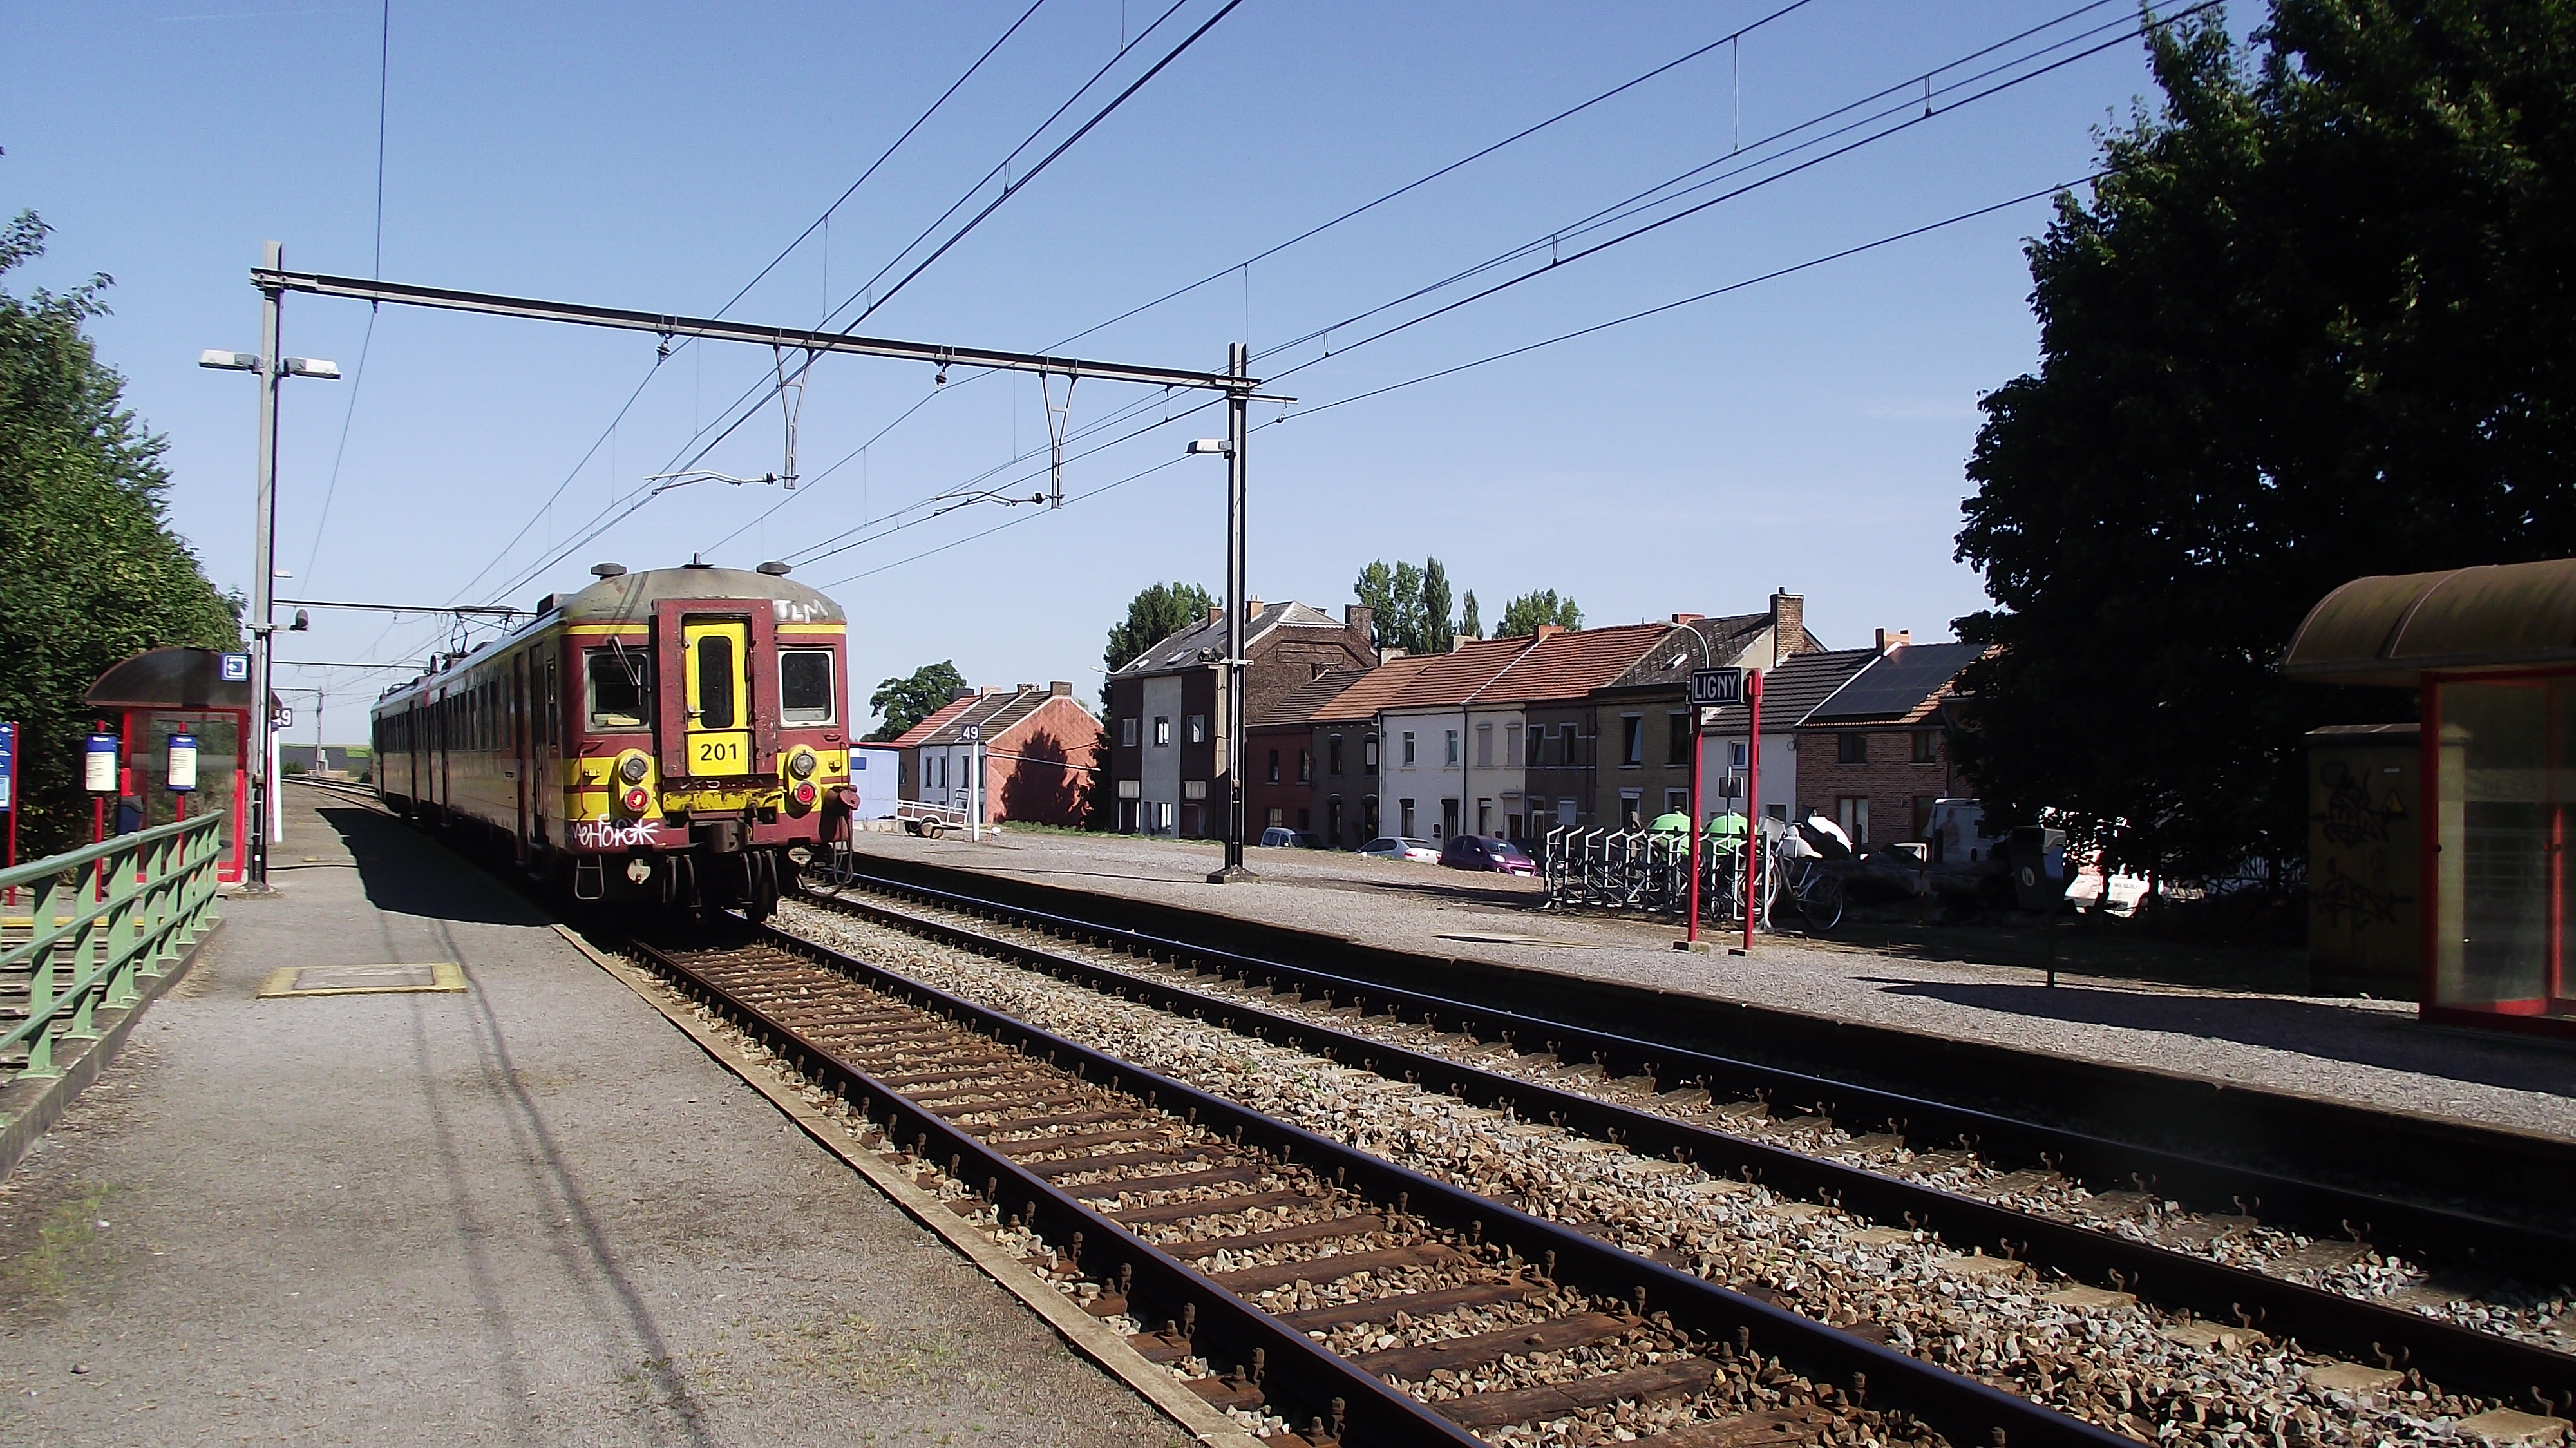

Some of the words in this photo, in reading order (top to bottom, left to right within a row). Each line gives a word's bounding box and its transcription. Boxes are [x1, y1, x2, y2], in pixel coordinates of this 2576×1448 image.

[773, 599, 828, 623] TLM
[1694, 674, 1737, 699] LIGNY
[963, 725, 978, 739] 49
[700, 743, 737, 761] 201
